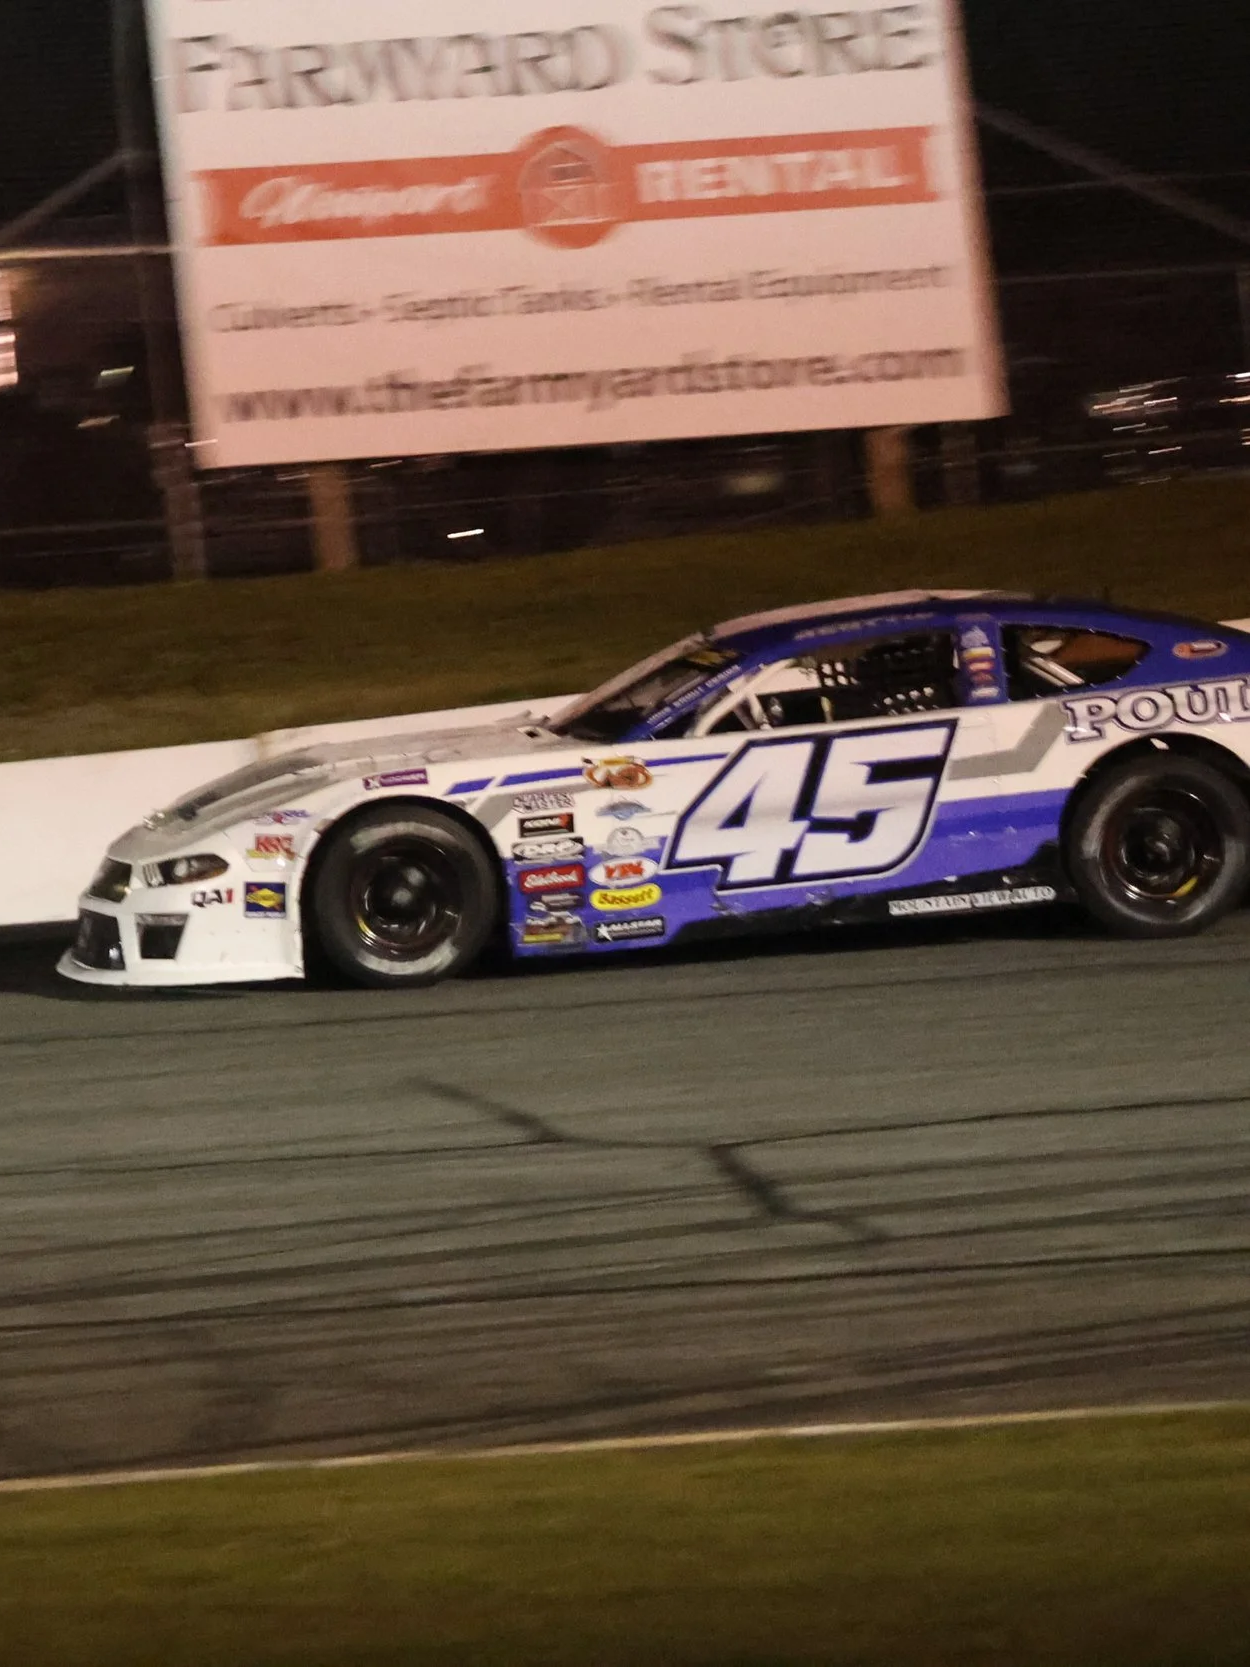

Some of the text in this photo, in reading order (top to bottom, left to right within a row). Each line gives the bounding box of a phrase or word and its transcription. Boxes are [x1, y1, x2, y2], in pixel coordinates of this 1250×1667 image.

[174, 3, 936, 113] FARMYARD STORE
[636, 146, 913, 203] RENTAL
[660, 718, 959, 892] 45
[192, 887, 234, 908] QA1
